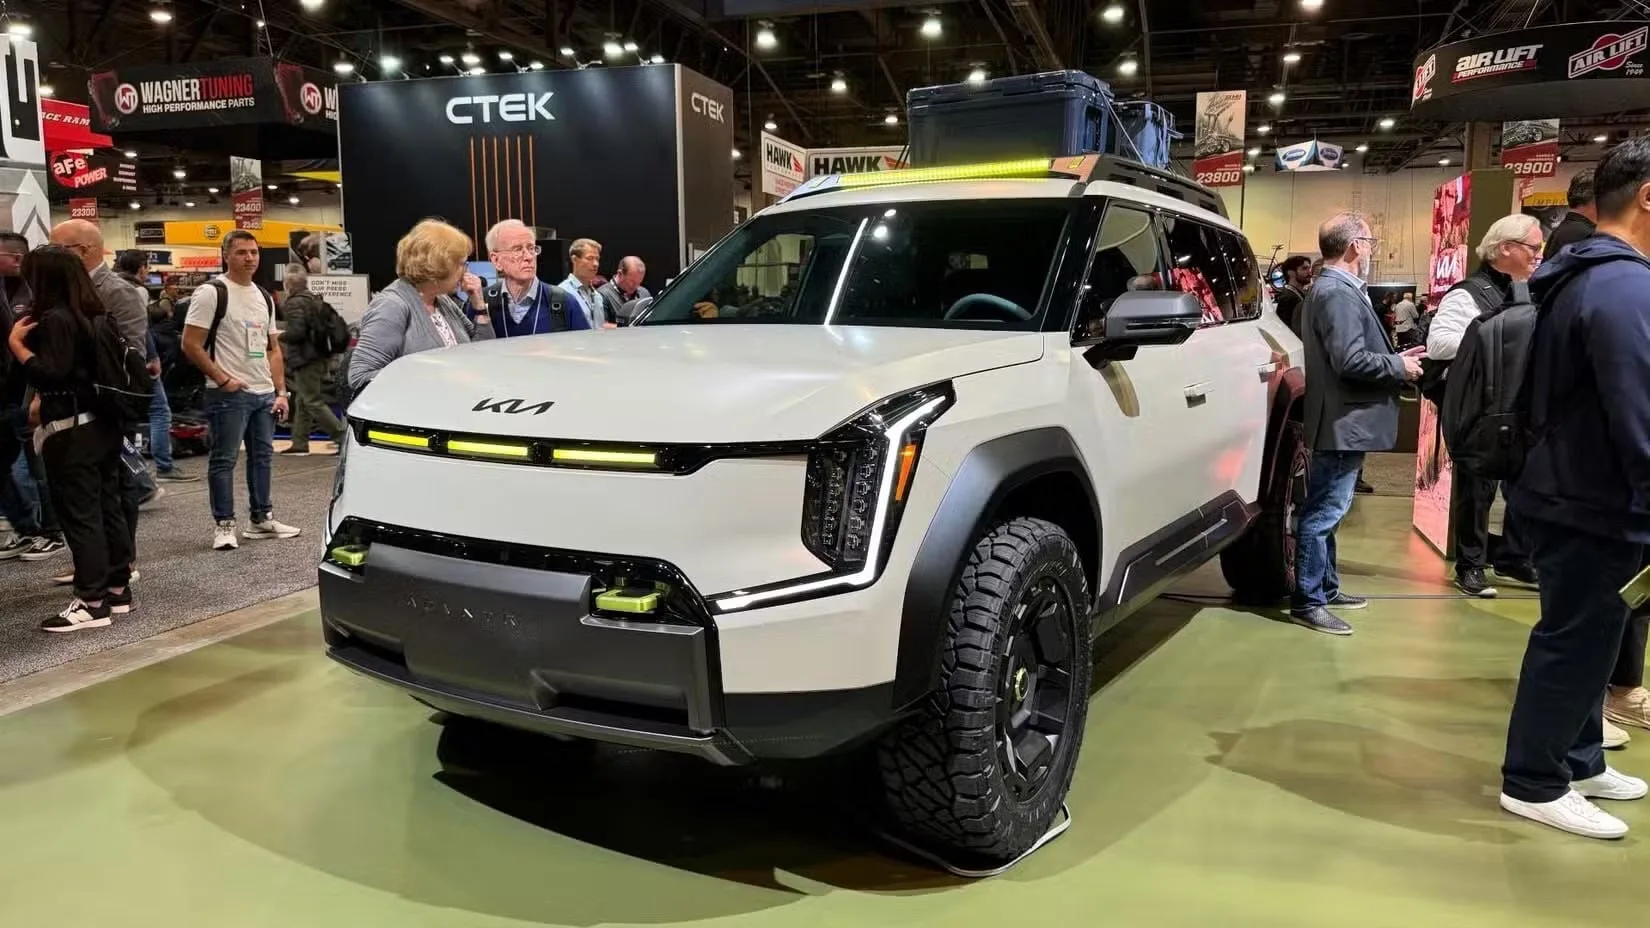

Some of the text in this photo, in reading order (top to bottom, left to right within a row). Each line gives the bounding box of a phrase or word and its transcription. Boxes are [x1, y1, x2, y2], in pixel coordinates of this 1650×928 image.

[1494, 44, 1544, 64] LIFT
[1573, 33, 1644, 71] AIR LIFT
[143, 96, 255, 114] HIGH PERFORMANCE PARTS
[446, 92, 556, 125] CTEK
[691, 92, 725, 124] CTEK
[766, 143, 793, 171] HAWK
[814, 155, 882, 175] HAWK
[74, 167, 108, 188] POWER
[1196, 171, 1240, 184] 23800
[71, 208, 96, 217] 23300
